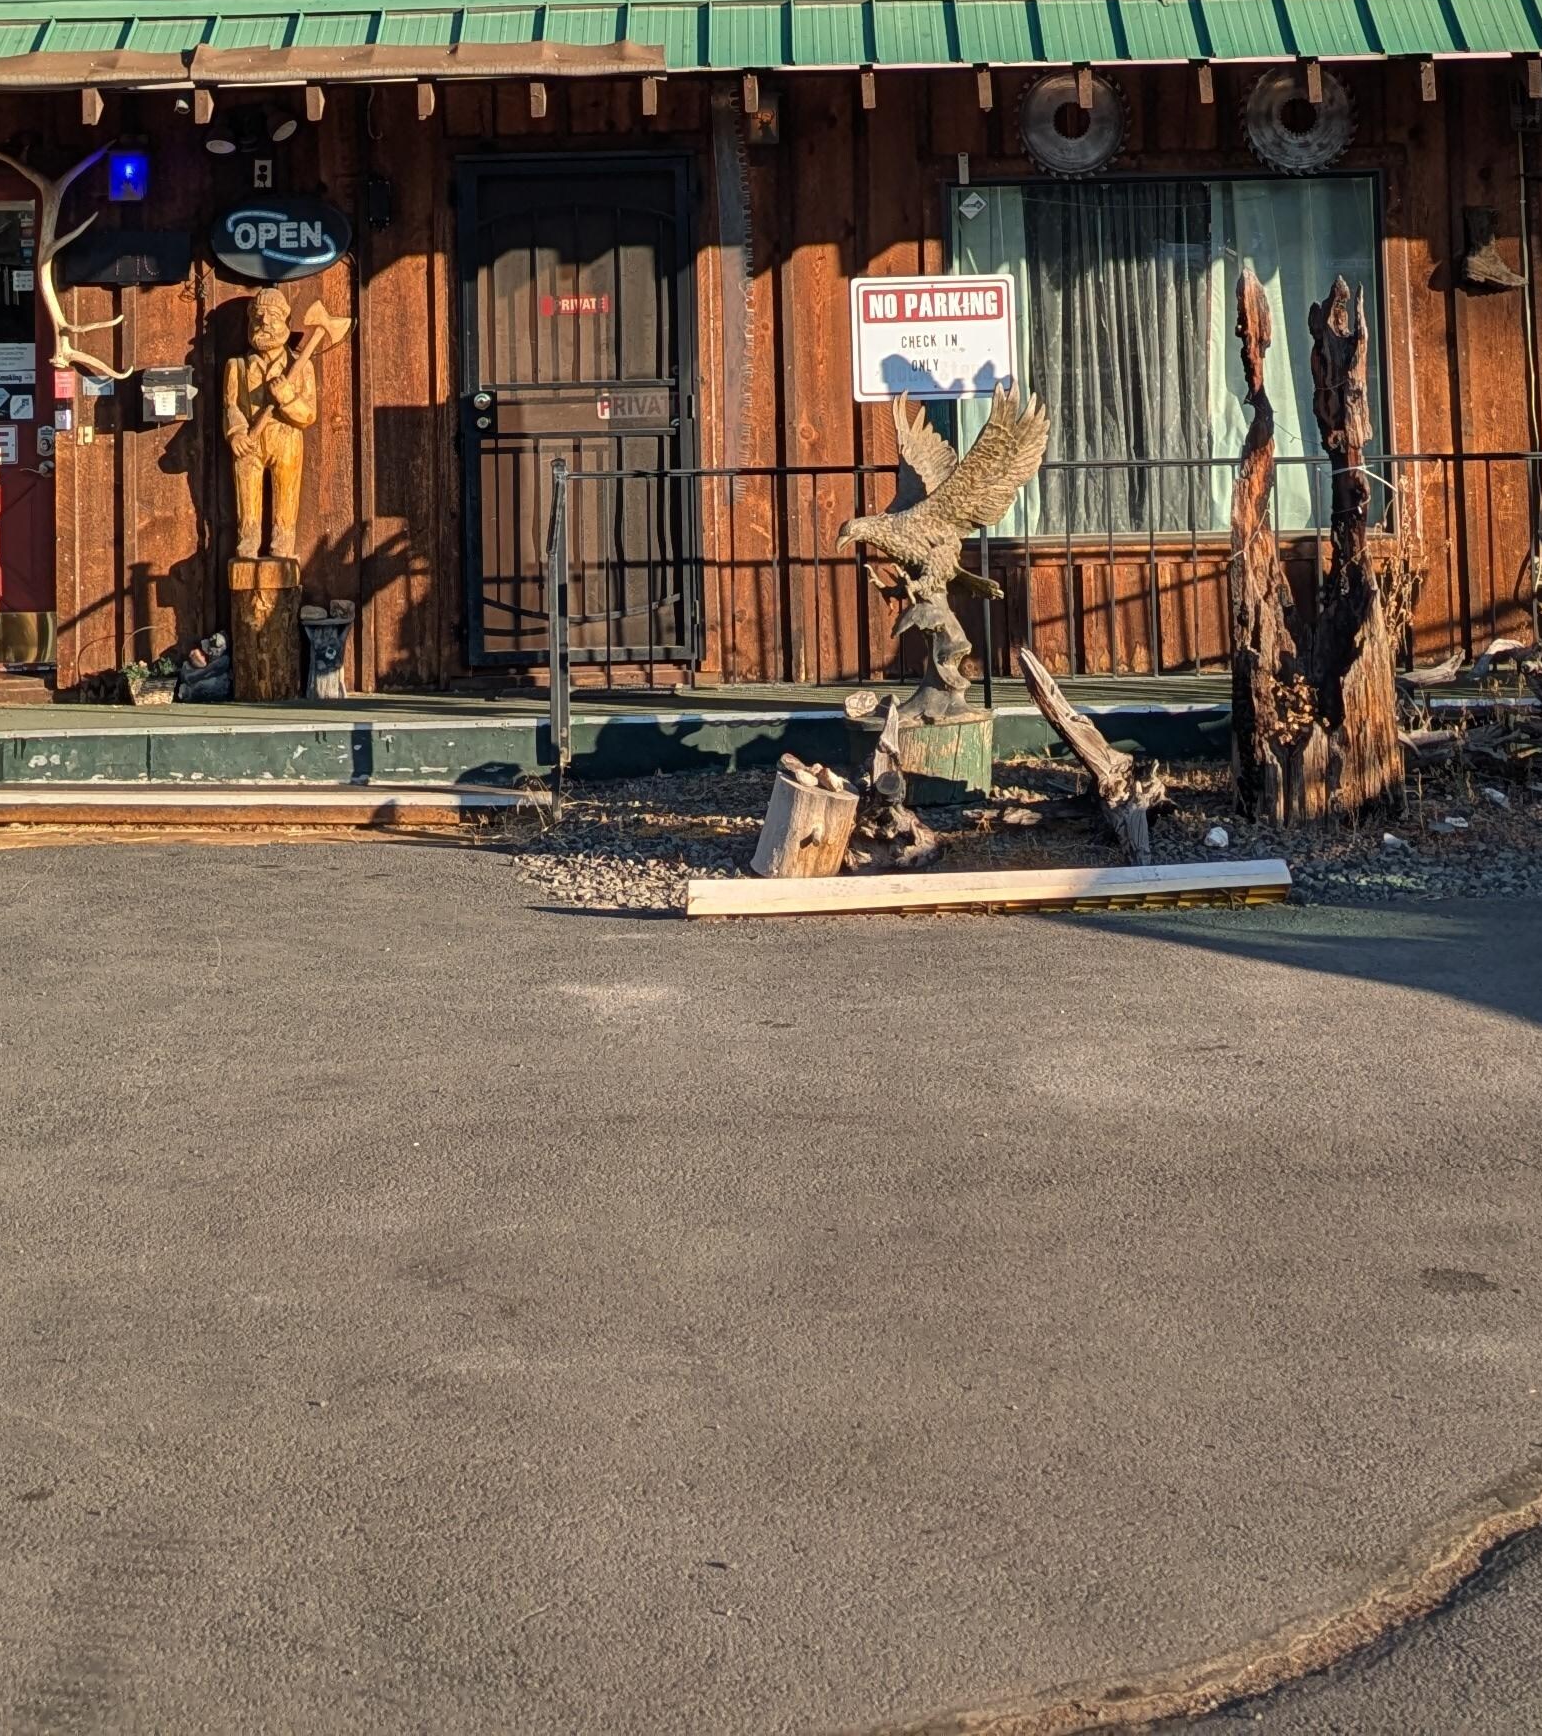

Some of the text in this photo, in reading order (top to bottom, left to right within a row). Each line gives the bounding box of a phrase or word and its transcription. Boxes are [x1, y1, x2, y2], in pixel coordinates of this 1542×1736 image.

[234, 221, 322, 250] OPEN
[869, 291, 998, 319] NO PARKING
[901, 334, 958, 348] CHECK IN
[911, 359, 939, 372] ONLY
